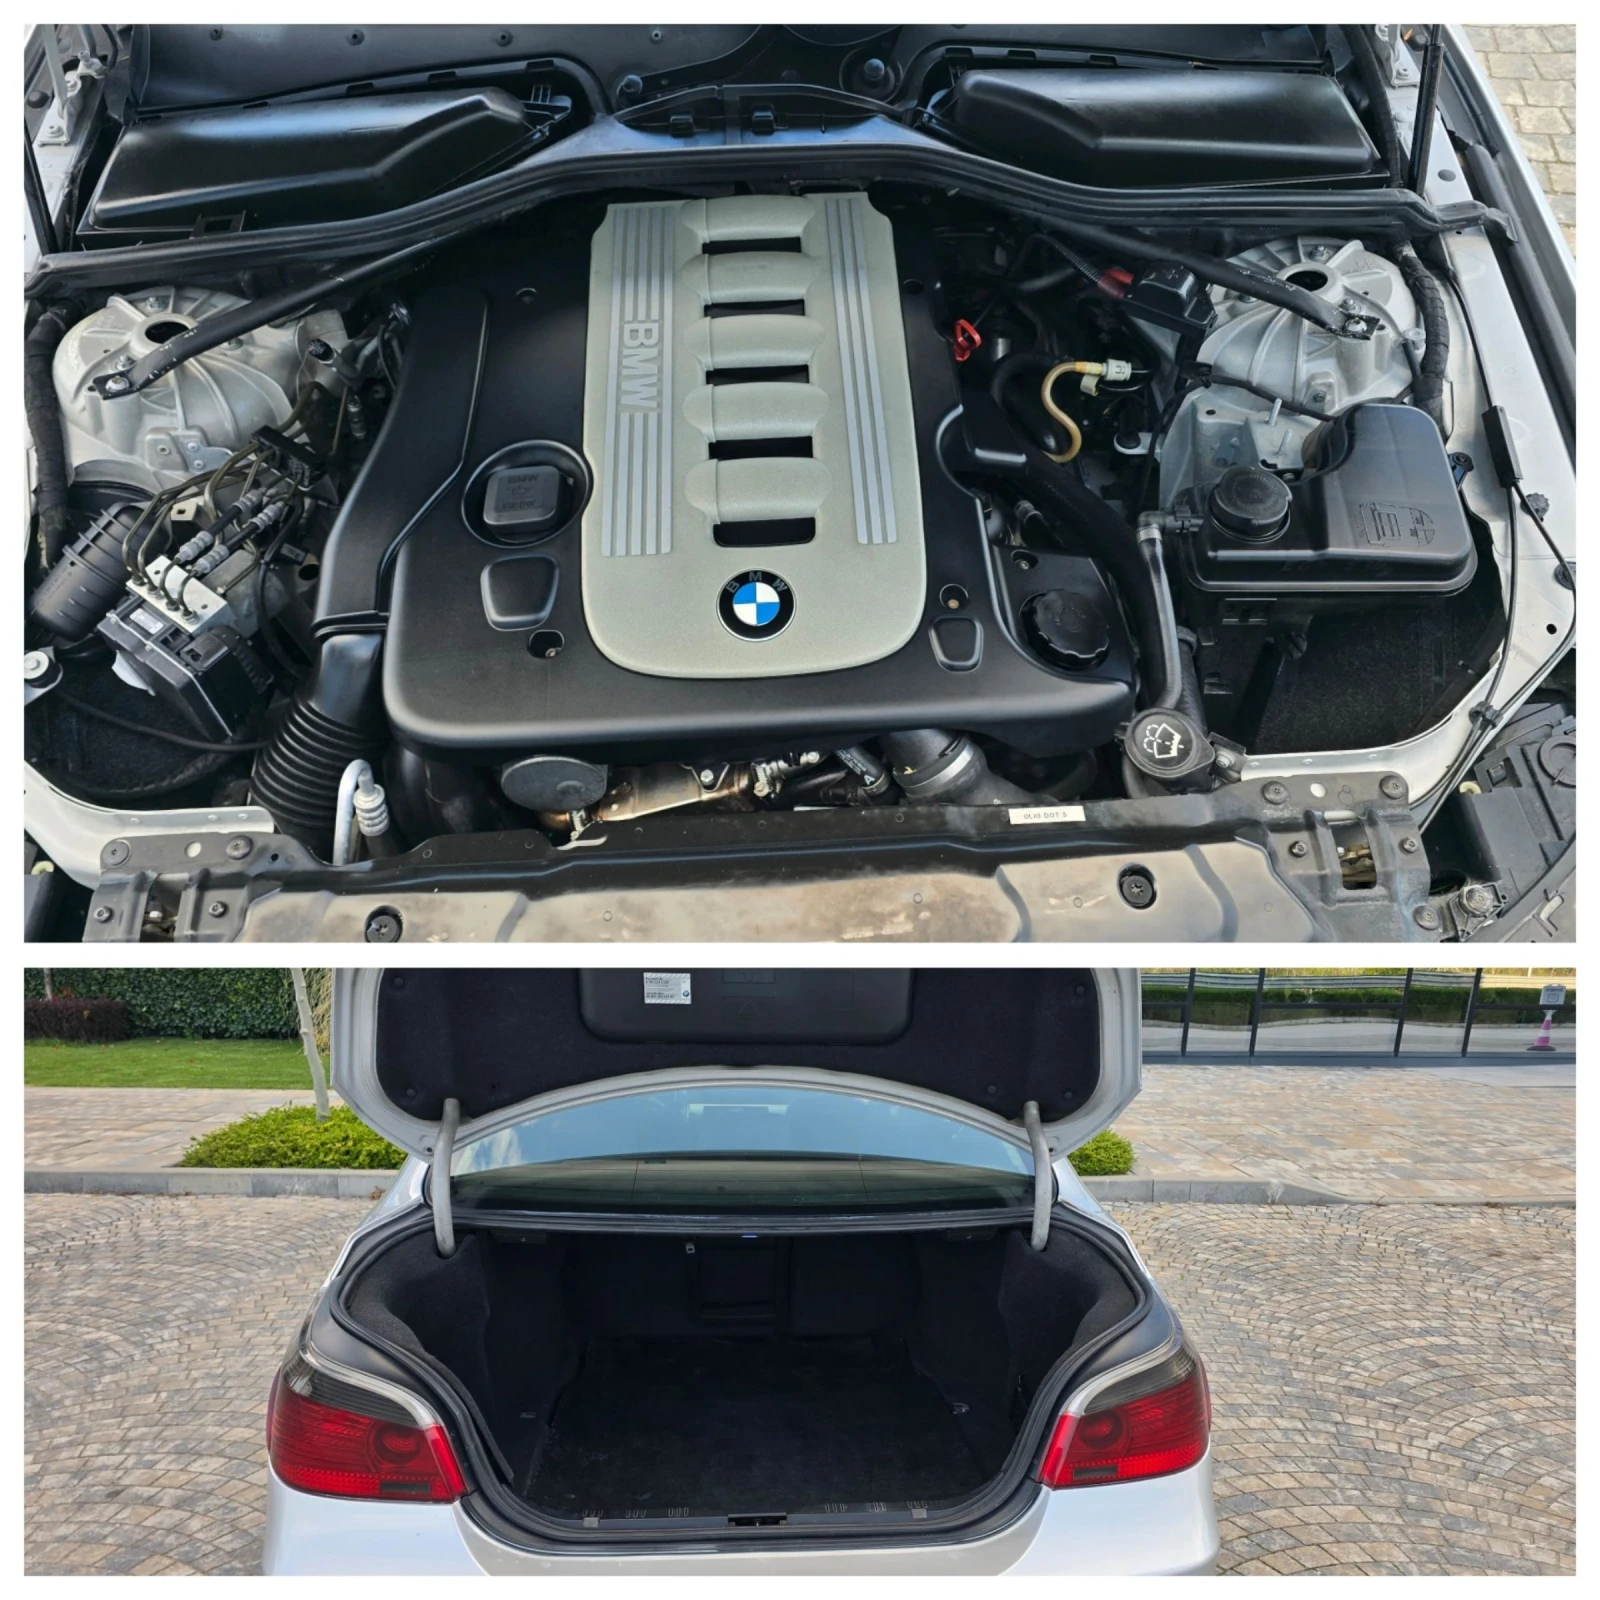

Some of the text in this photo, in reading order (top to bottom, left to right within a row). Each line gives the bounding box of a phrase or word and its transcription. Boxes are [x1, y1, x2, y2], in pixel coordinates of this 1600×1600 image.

[620, 322, 660, 409] BMW
[725, 571, 788, 594] BMW
[1023, 812, 1042, 820] OLIO
[1043, 811, 1060, 819] DOT
